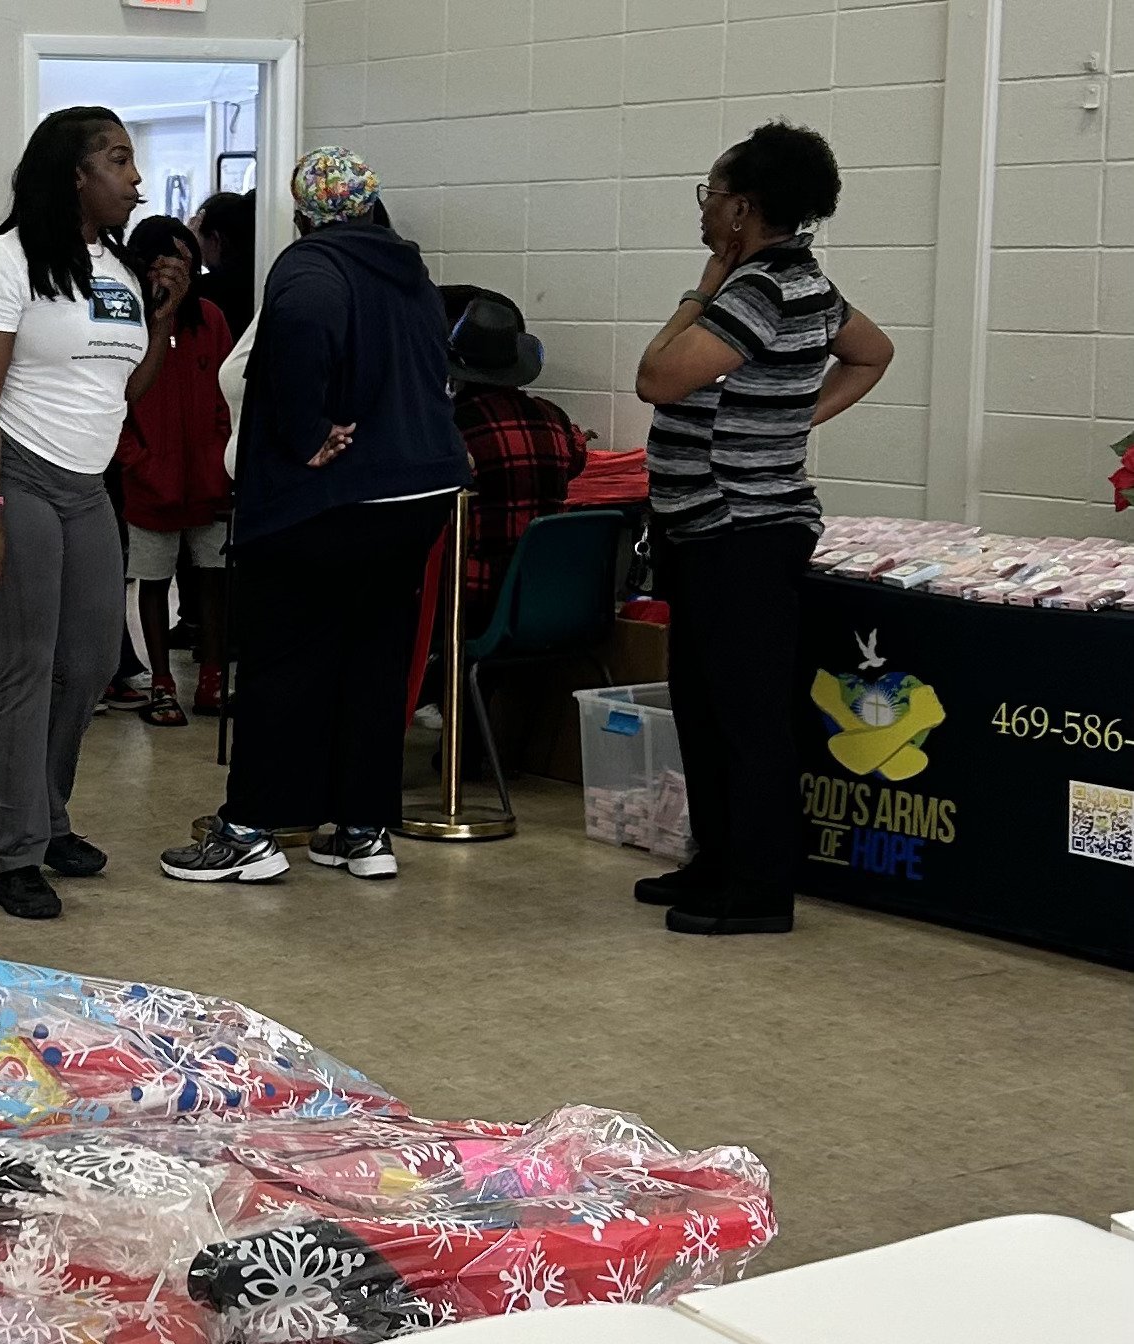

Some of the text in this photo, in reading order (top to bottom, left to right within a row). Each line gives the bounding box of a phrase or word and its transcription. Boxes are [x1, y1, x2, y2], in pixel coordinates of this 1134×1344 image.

[991, 701, 1134, 752] 469-586-
[799, 771, 957, 844] GOD'S ARMS
[819, 826, 926, 881] OF HOPE
